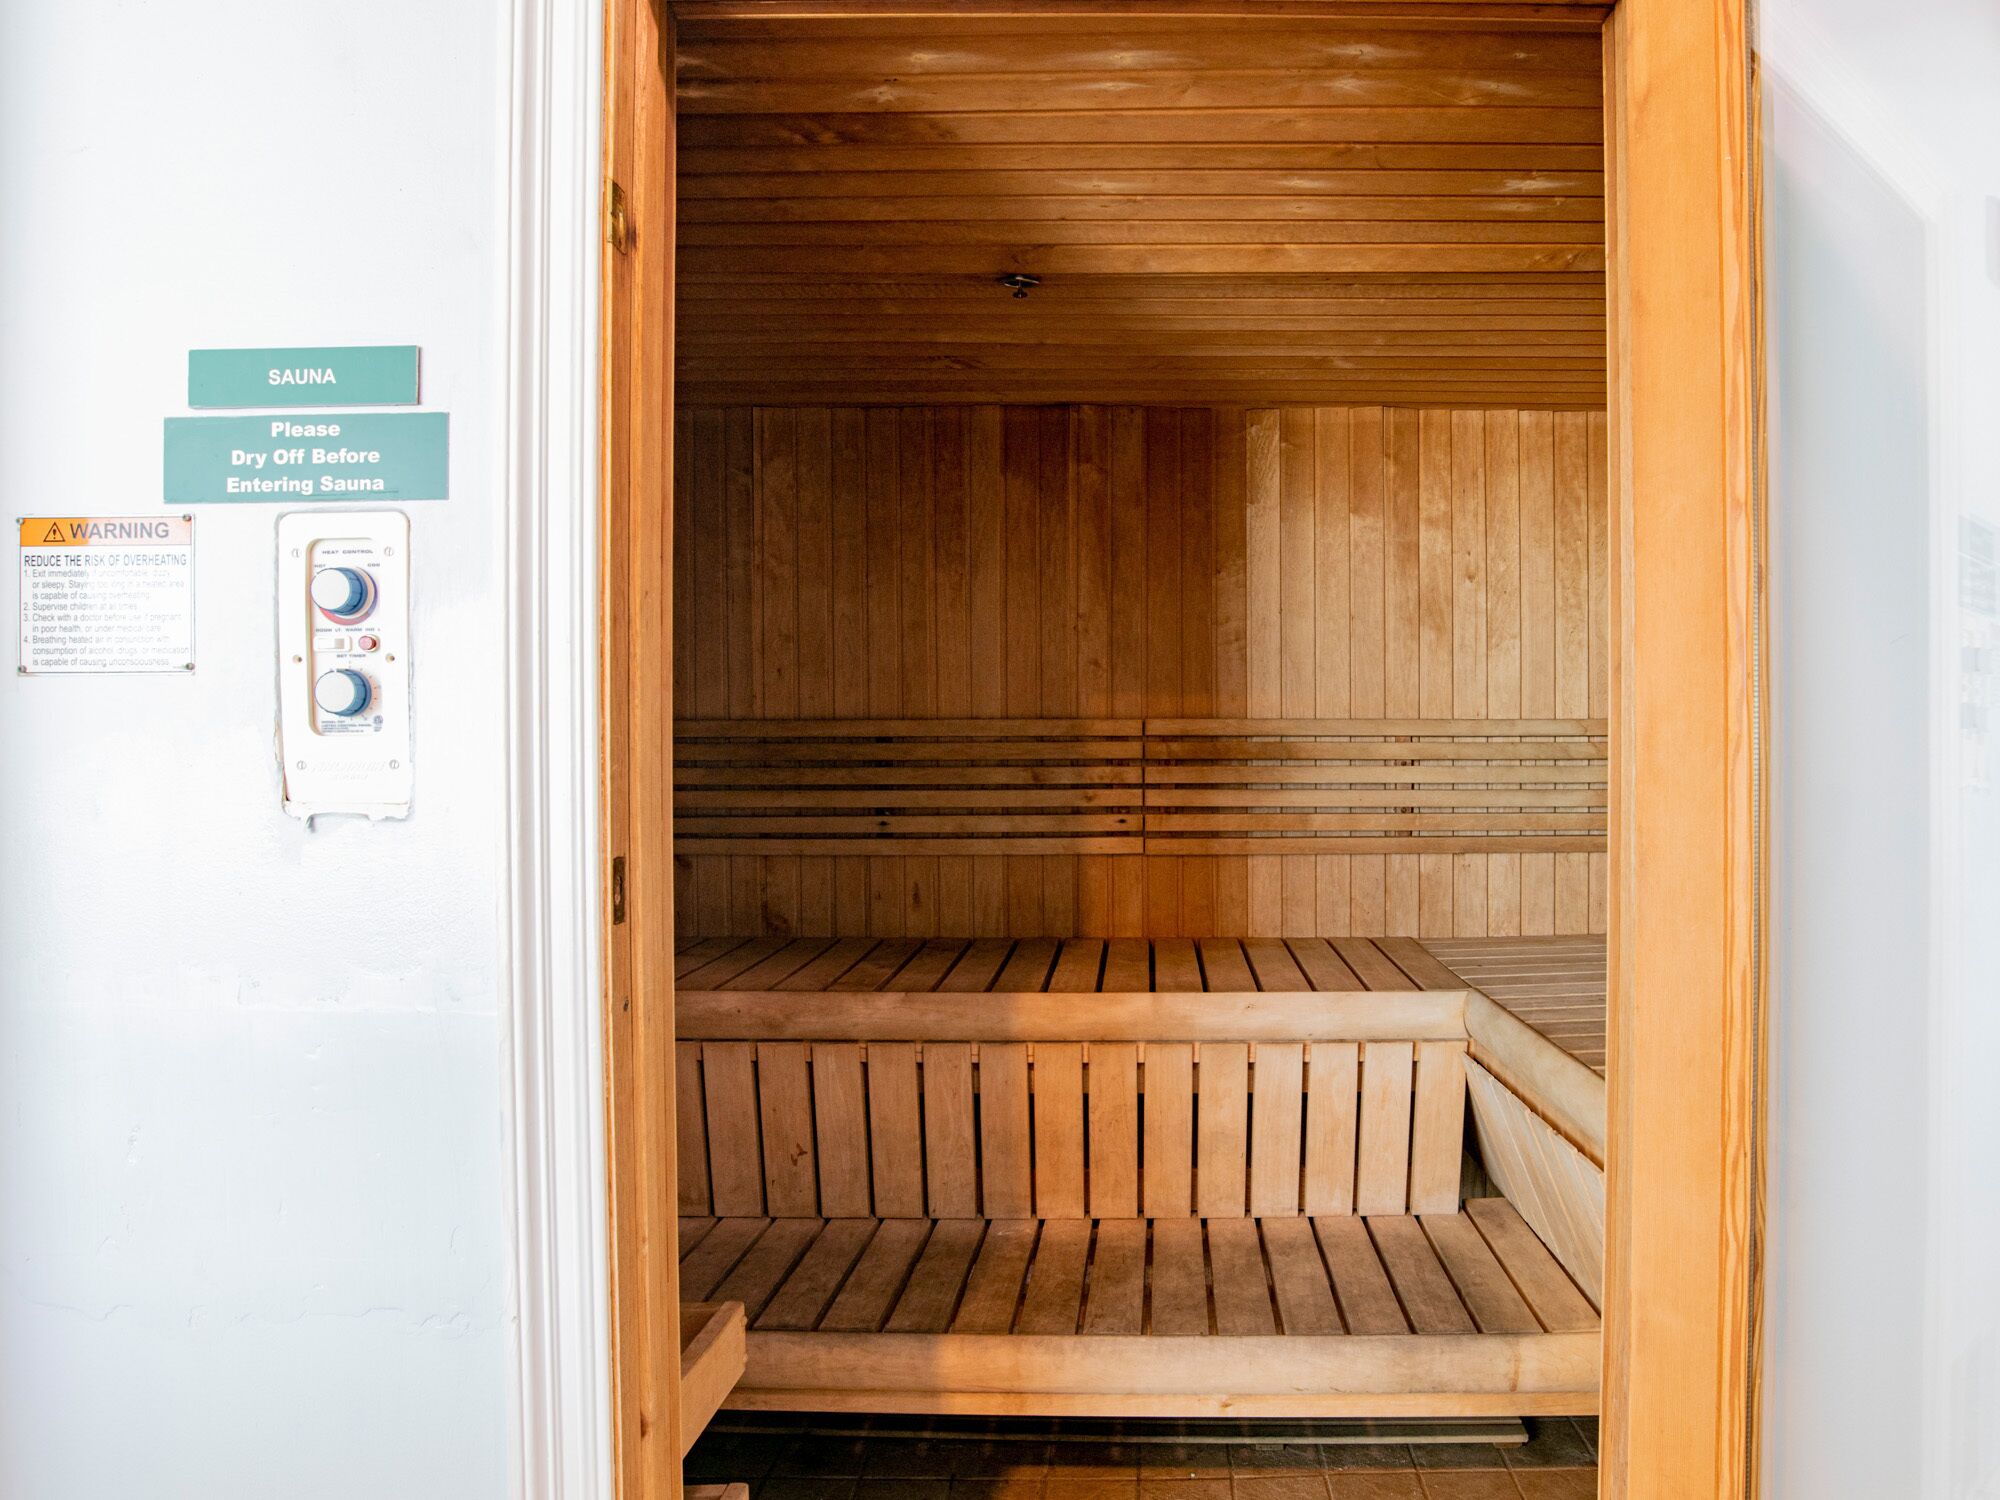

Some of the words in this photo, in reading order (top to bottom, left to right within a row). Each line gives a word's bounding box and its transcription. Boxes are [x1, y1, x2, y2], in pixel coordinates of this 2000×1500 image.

[268, 368, 336, 385] SAUNA
[271, 421, 341, 438] Please
[231, 449, 267, 469] Dry
[273, 448, 305, 465] Off
[311, 448, 380, 464] Before
[226, 476, 313, 496] Entering
[320, 475, 384, 491] Sauna
[70, 522, 169, 539] WARNING
[24, 555, 62, 567] REDUCE
[64, 555, 82, 567] THE
[84, 555, 106, 567] RISK
[108, 554, 120, 566] OF
[123, 553, 187, 566] OVERHEATING
[23, 570, 30, 578] 1.
[32, 569, 46, 578] Exit
[48, 569, 89, 580] immediately
[32, 591, 39, 600] is
[40, 591, 69, 602] capable
[70, 591, 78, 600] of
[23, 602, 31, 611] 2.
[32, 602, 68, 612] Supervise
[70, 602, 97, 611] children
[23, 613, 31, 622] 3.
[32, 613, 55, 622] Check
[57, 613, 72, 622] with
[80, 613, 103, 622] doctor
[104, 612, 127, 622] before
[32, 624, 39, 633] in
[41, 626, 58, 635] poor
[95, 624, 115, 633] under
[23, 635, 31, 644] 4.
[32, 635, 66, 647] Breathing
[69, 635, 92, 644] heated
[95, 636, 104, 644] air
[32, 647, 78, 657] consumption
[79, 647, 88, 656] of
[151, 646, 189, 655] medication
[32, 657, 39, 667] is
[40, 657, 69, 668] capable
[70, 657, 78, 667] of
[79, 658, 108, 669] causing
